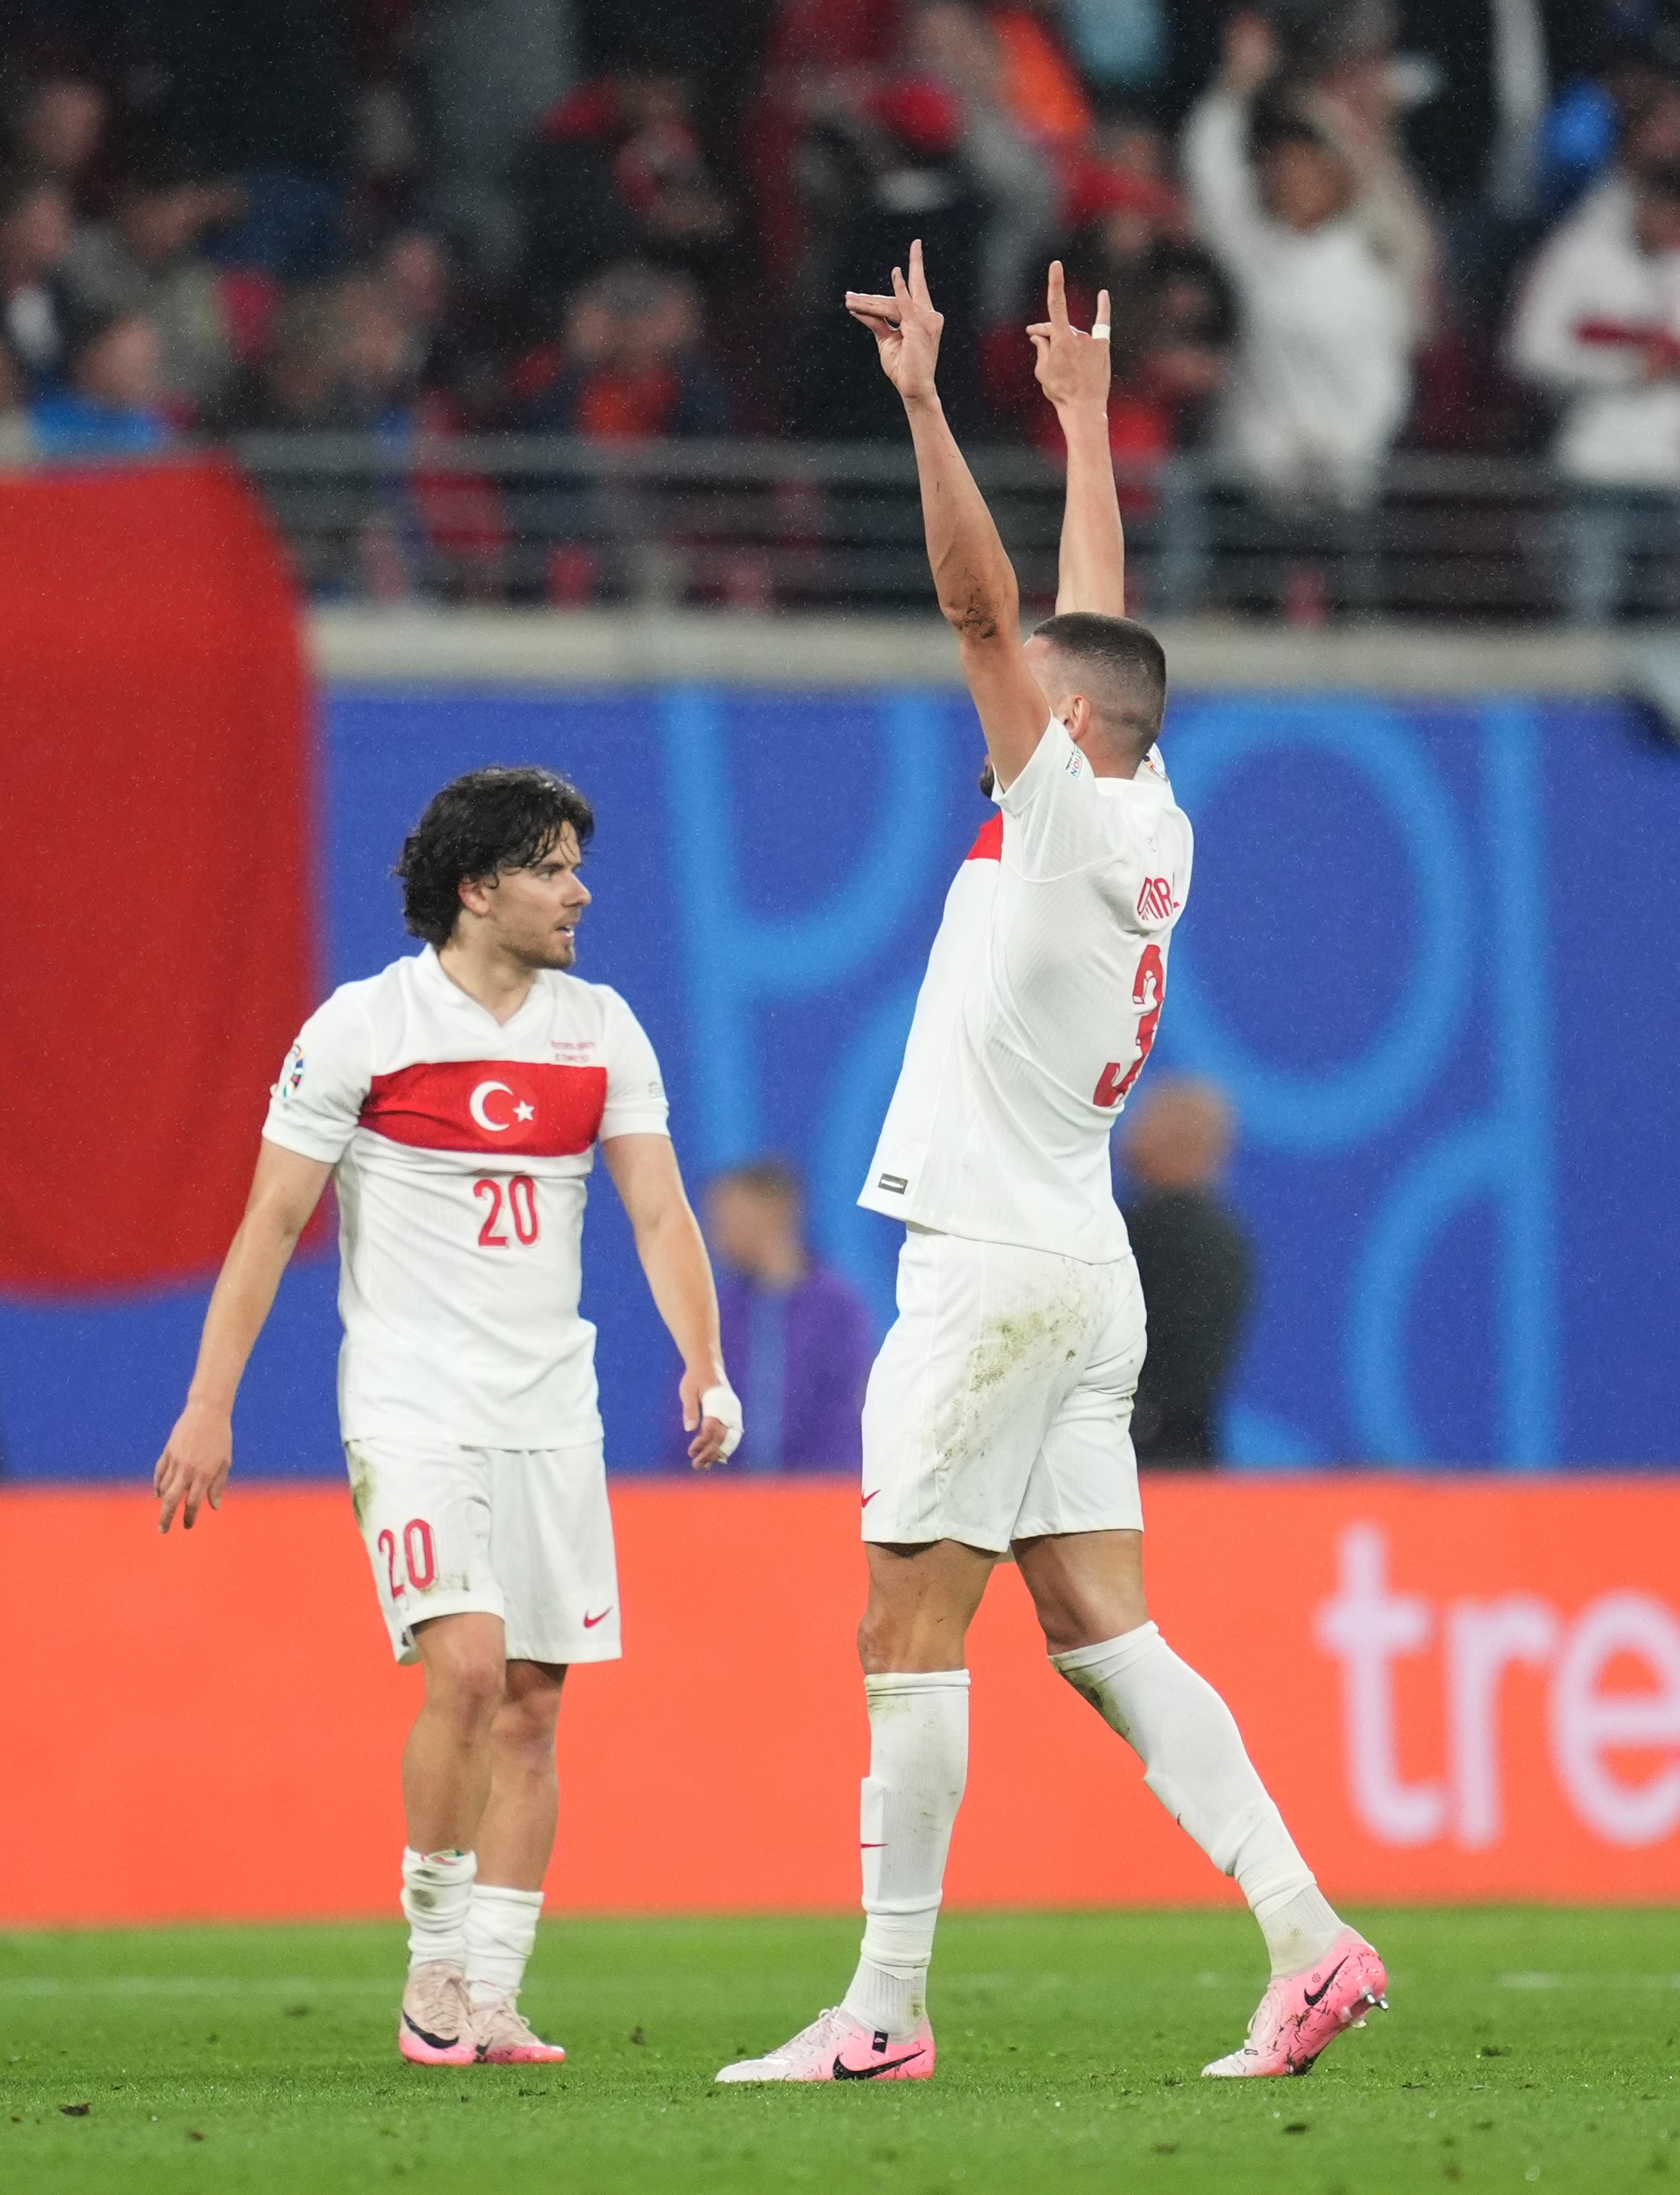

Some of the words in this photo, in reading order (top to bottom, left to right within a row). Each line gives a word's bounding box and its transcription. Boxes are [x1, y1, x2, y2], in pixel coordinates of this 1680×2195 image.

[1093, 944, 1164, 1107] 3
[473, 1175, 538, 1247] 20
[378, 1518, 437, 1599] 20
[1315, 1521, 1680, 1851] tre
